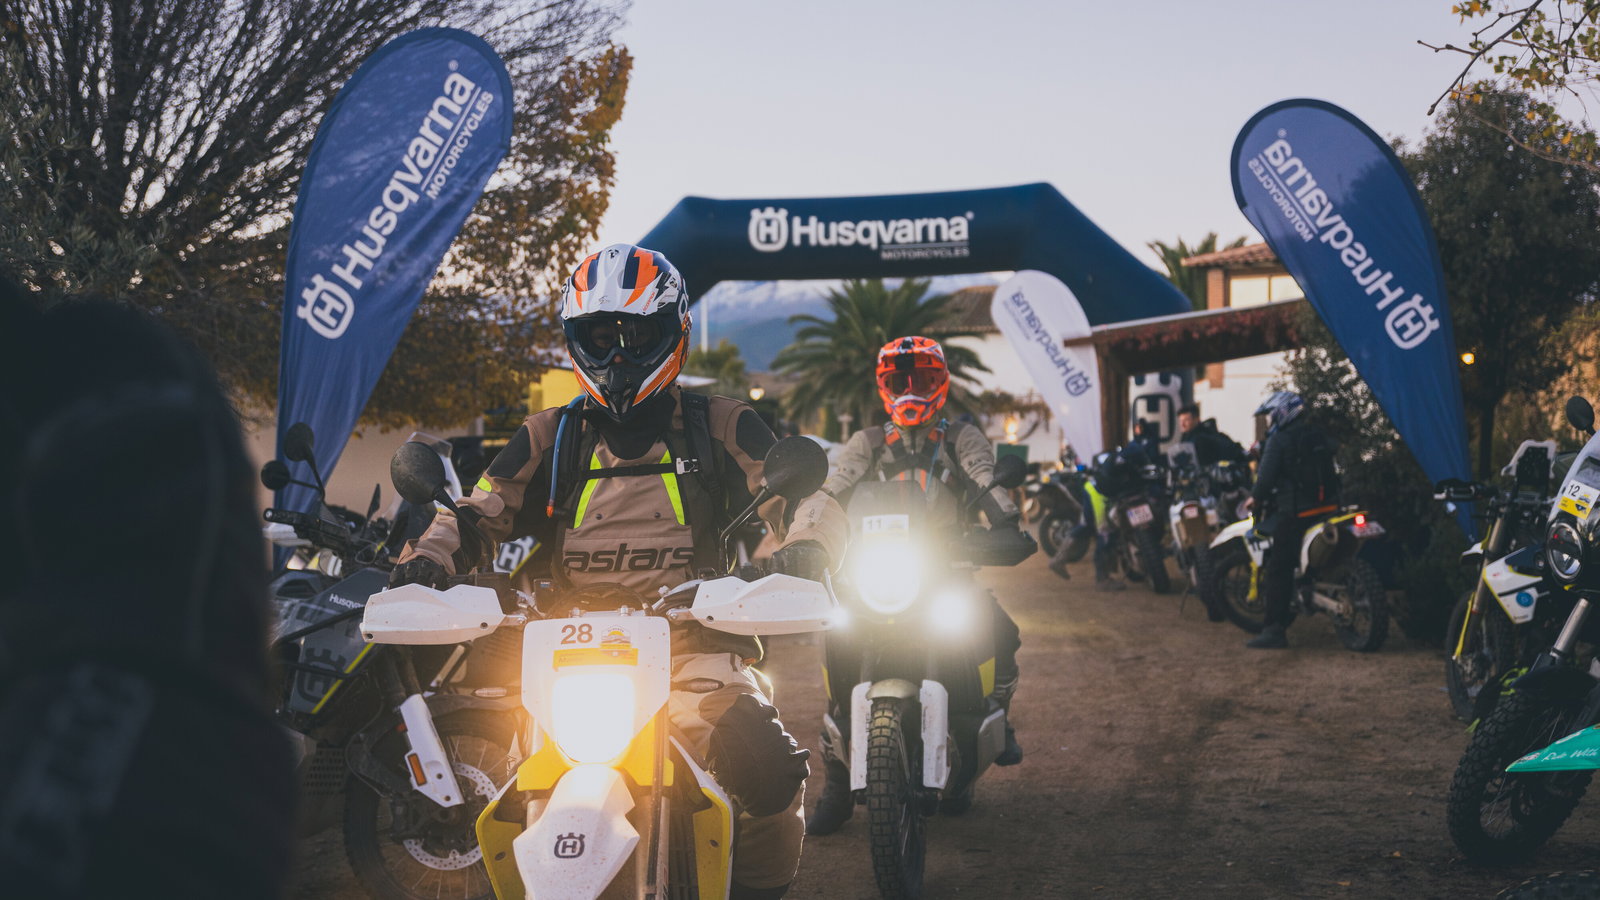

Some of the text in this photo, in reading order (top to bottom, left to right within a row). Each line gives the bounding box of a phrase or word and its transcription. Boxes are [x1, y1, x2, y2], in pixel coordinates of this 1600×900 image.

[426, 91, 494, 200] MOTORCYCLES
[331, 71, 476, 291] Husqvarna
[792, 214, 970, 250] Husqvarna
[880, 247, 970, 260] MOTORCYCLES
[1568, 483, 1581, 497] 12
[562, 543, 694, 572] astars
[329, 593, 365, 609] Husqva
[560, 623, 593, 645] 28
